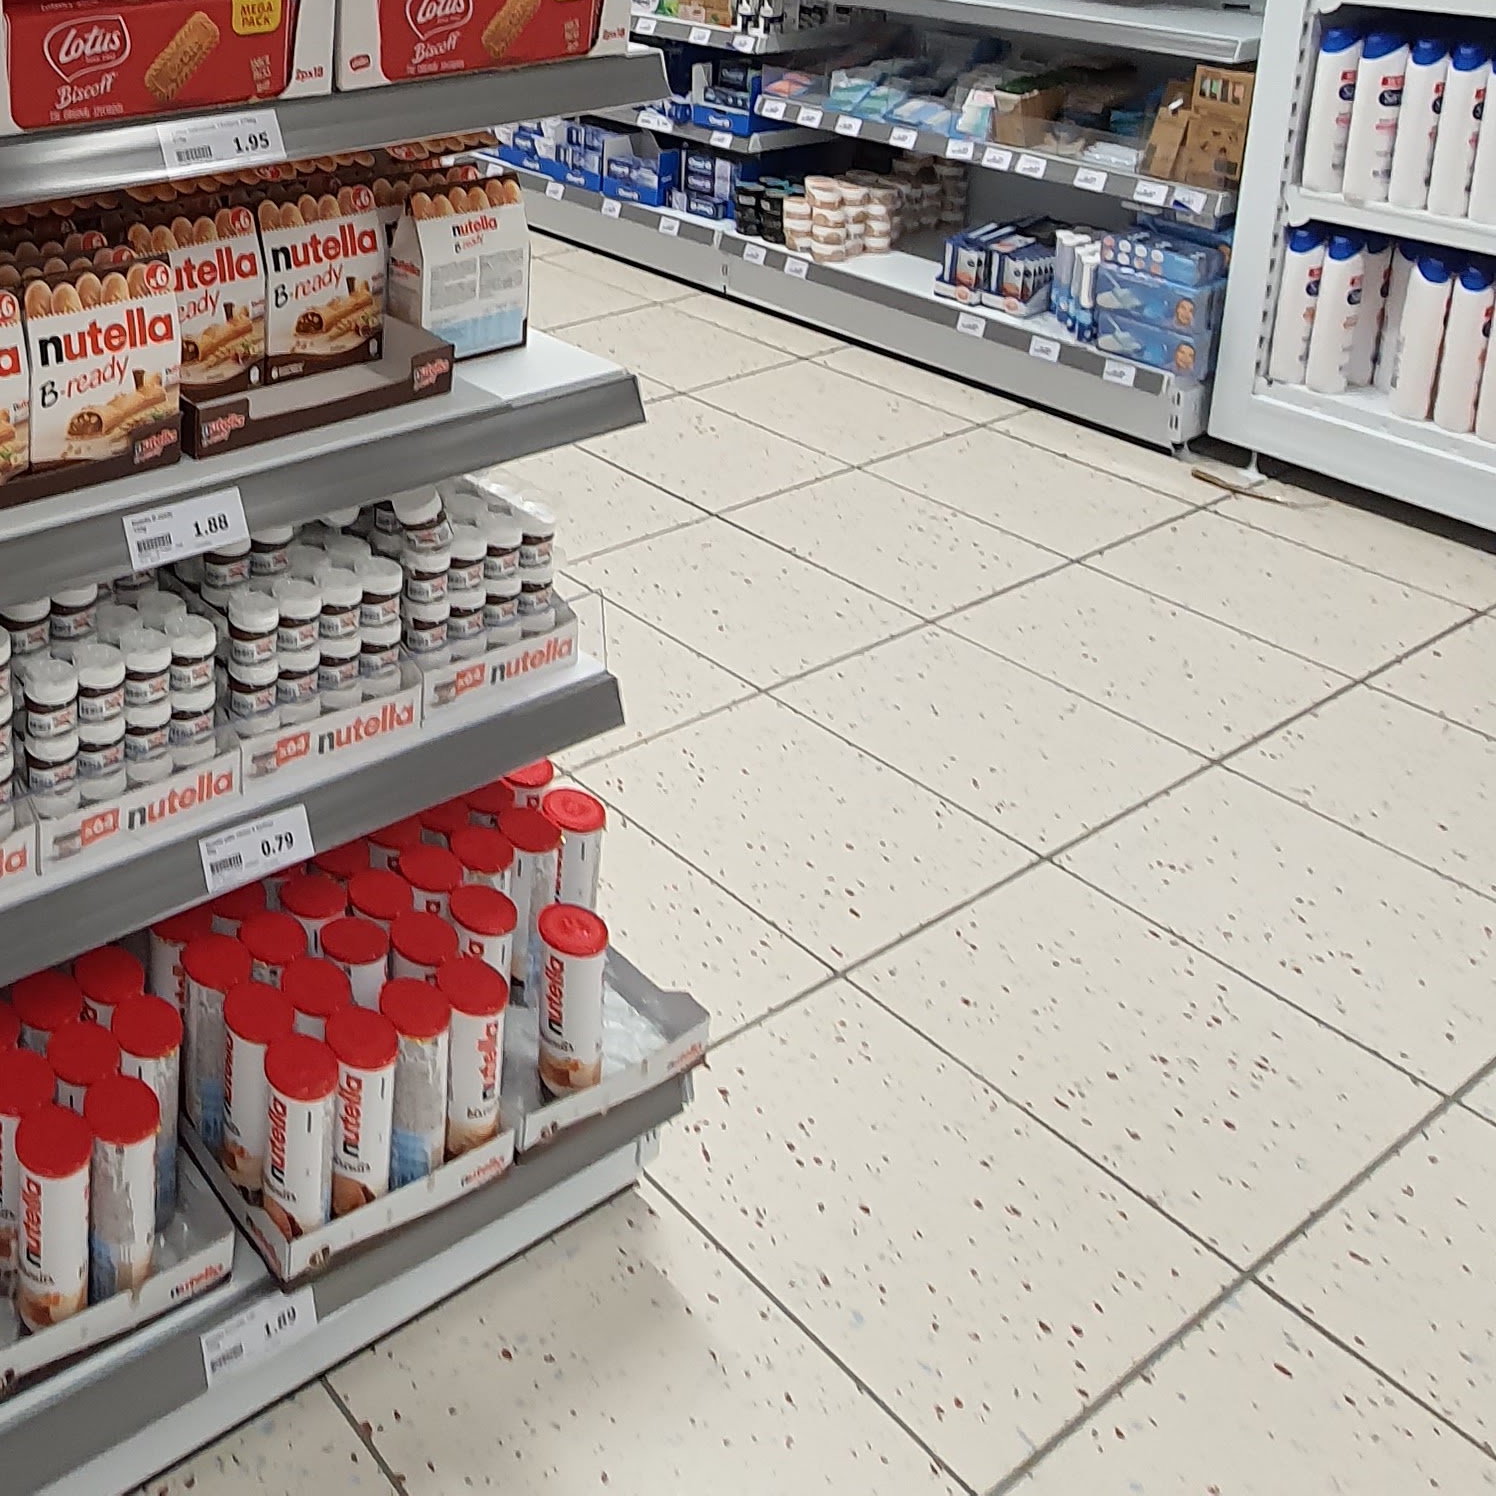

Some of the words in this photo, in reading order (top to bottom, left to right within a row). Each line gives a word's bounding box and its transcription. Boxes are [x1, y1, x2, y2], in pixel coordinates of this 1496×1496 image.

[240, 0, 273, 17] MEGA
[241, 14, 272, 28] PACK
[59, 25, 121, 64] Lotus
[411, 31, 461, 65] Biscoff
[55, 71, 117, 110] Biscoff
[232, 129, 270, 155] 1.95
[452, 215, 498, 237] nutella
[271, 223, 378, 273] nutella
[39, 307, 174, 368] nutella
[193, 512, 230, 538] 1.88
[491, 636, 574, 685] nutella
[317, 703, 415, 755] nutella
[127, 769, 233, 830] nutella
[260, 831, 294, 857] 0.79
[338, 1075, 363, 1159] nutella
[267, 1095, 288, 1185] nutella
